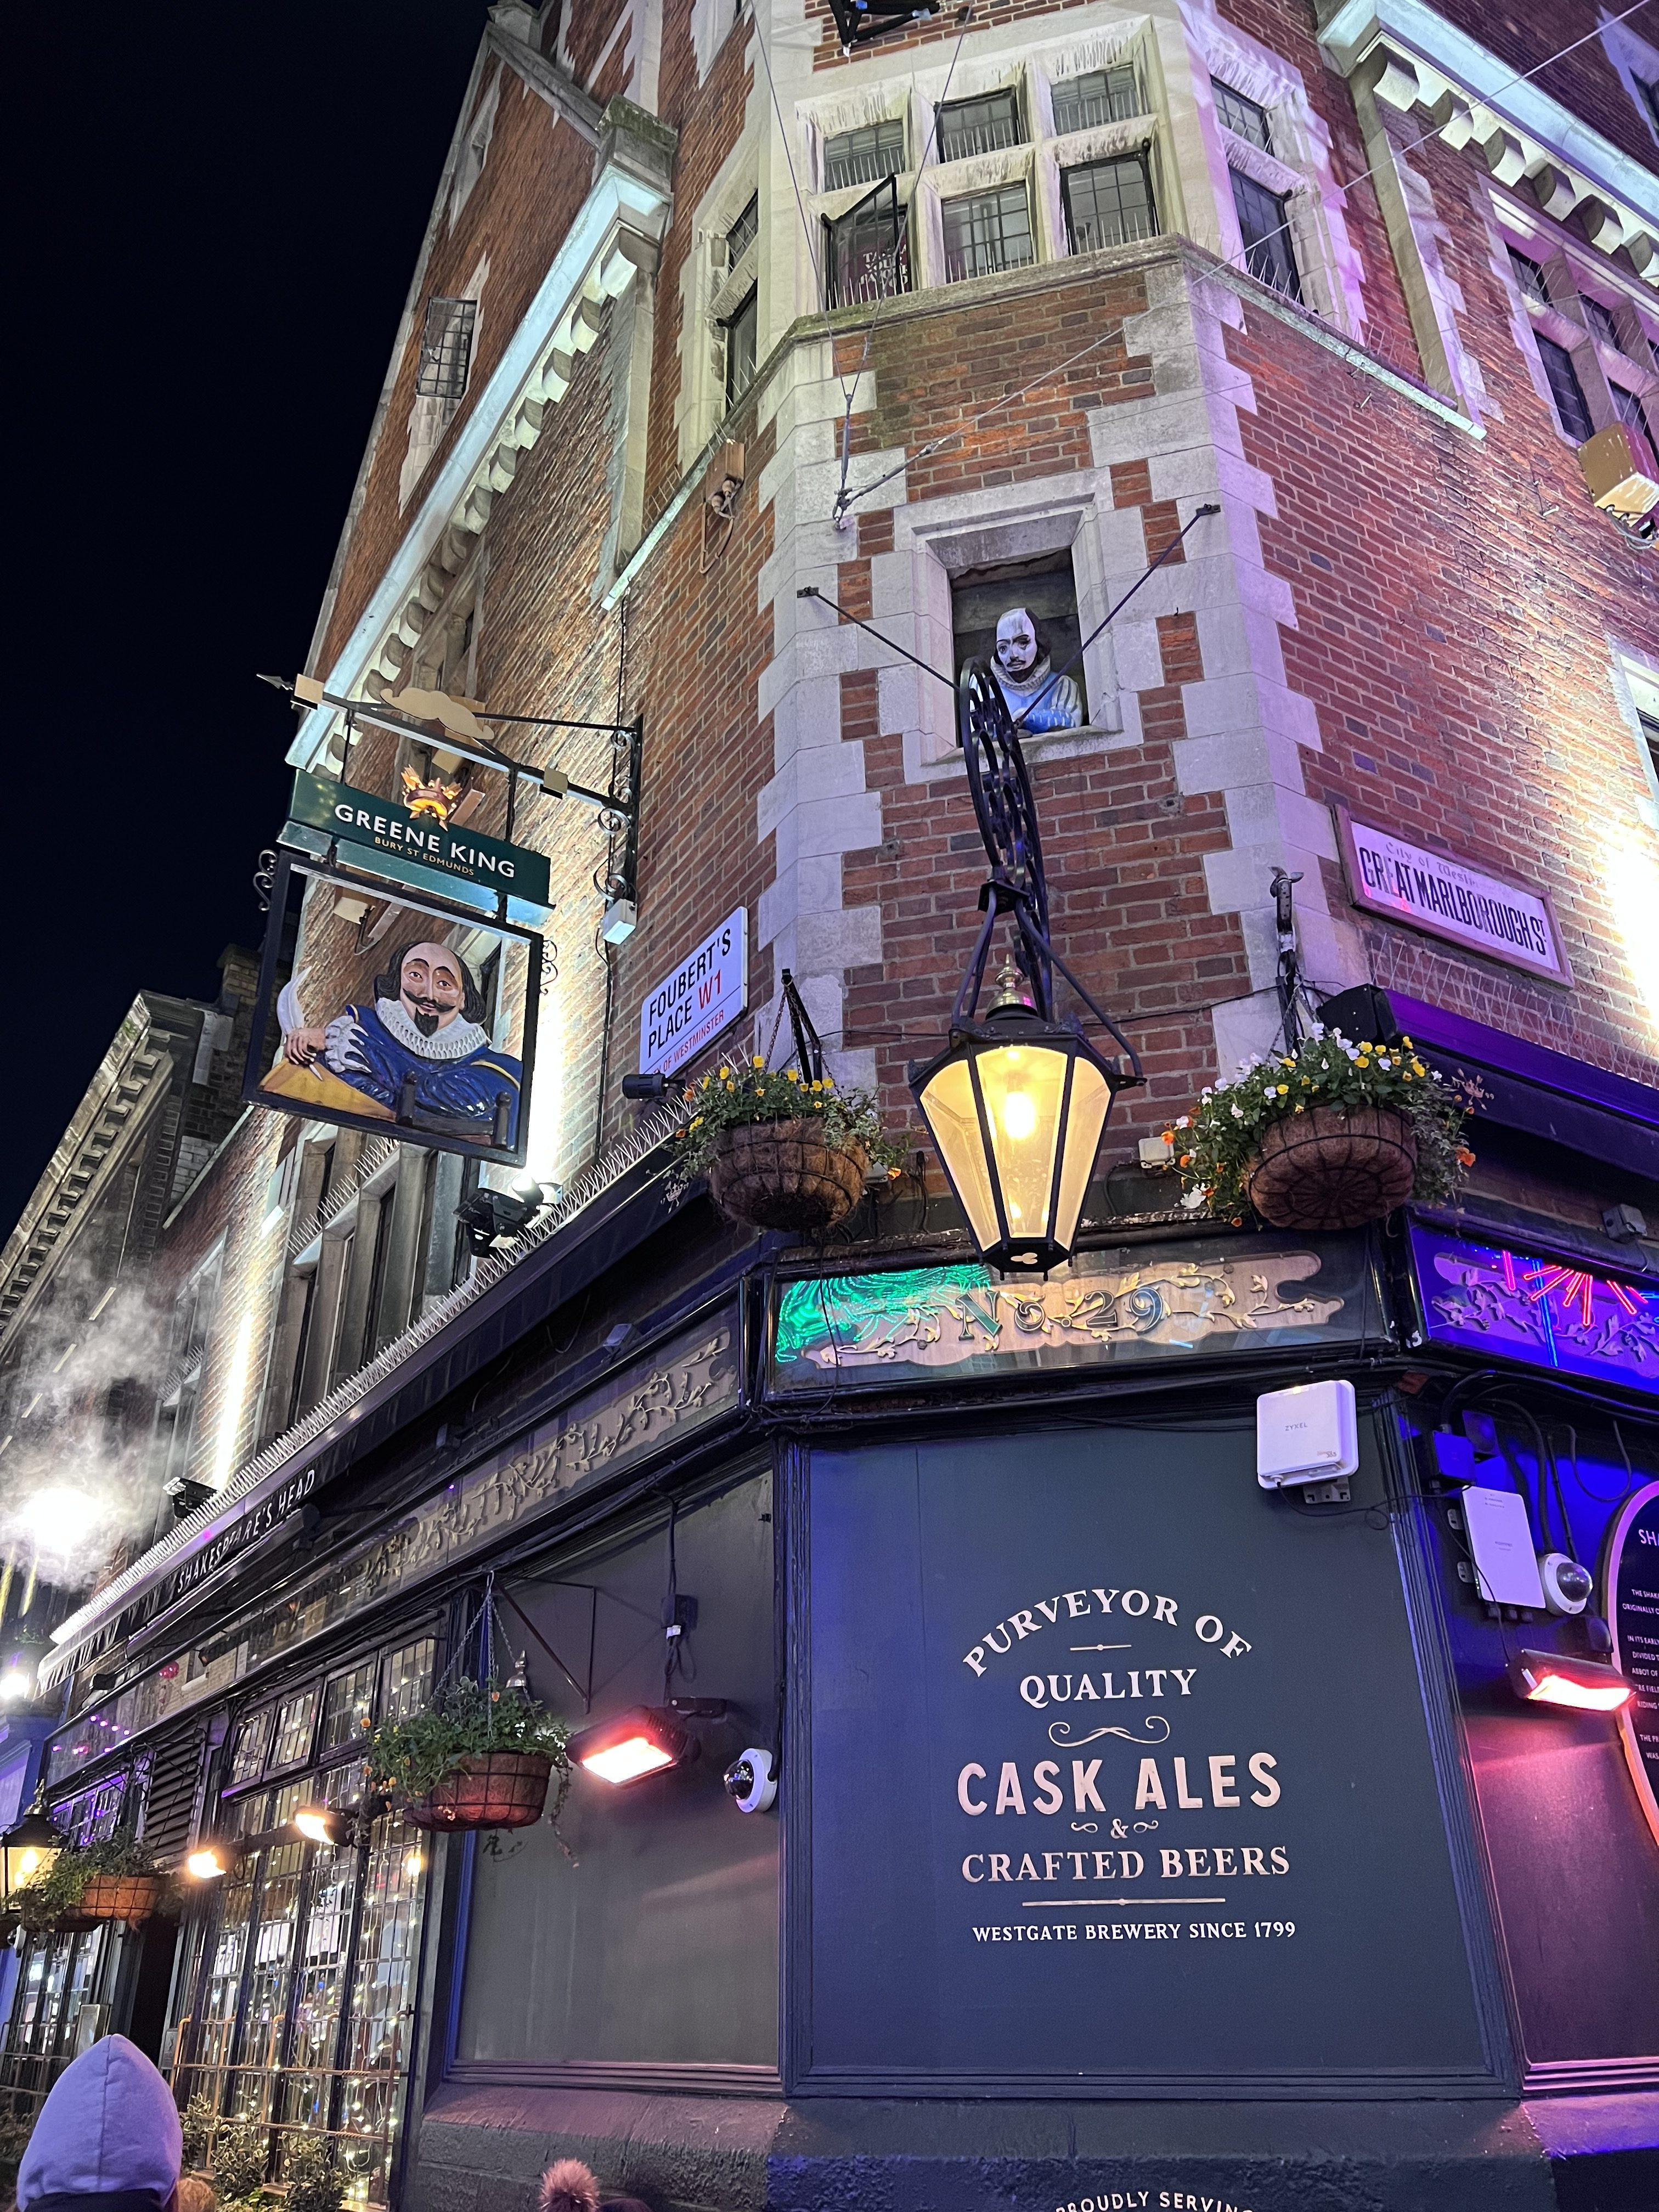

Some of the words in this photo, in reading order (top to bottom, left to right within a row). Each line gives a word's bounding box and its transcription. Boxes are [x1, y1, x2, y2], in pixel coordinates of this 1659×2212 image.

[335, 804, 441, 853] GREENE
[450, 842, 515, 878] KING
[375, 837, 403, 851] BURY
[407, 847, 419, 857] ST
[423, 853, 475, 876] EDMUNDS
[1359, 847, 1415, 904] GREAT
[1414, 868, 1534, 951] MARLBOROUGH
[649, 928, 731, 1028] FOUBERT'S
[648, 995, 692, 1059] PLACE
[698, 969, 721, 1010] W1
[664, 1056, 672, 1072] OF
[674, 1009, 724, 1063] WESTMINSTER
[1084, 1286, 1164, 1335] 29
[1285, 1422, 1308, 1431] ZYXEL
[276, 1469, 315, 1519] HEAD
[1639, 1529, 1659, 1546] SH
[1622, 1603, 1654, 1614] ORIGINALLY
[963, 1589, 1178, 1677] PURVEYOR
[1195, 1616, 1251, 1658] OF
[1632, 1651, 1655, 1661] DIVIDED
[1632, 1668, 1649, 1676] ABBOT
[1020, 1669, 1197, 1708] QUALITY
[1639, 1734, 1651, 1742] THE
[958, 1759, 1106, 1815] CASK
[1135, 1753, 1280, 1810] ALES
[1111, 1819, 1129, 1839] &
[962, 1851, 1144, 1882] CRAFTED
[1160, 1846, 1289, 1877] BEERS
[973, 1925, 1077, 1942] WESTGATE
[1086, 1924, 1181, 1939] BREWERY
[1189, 1922, 1246, 1938] SINCE
[1255, 1922, 1295, 1938] 1799
[1160, 2192, 1253, 2212] SERVIN
